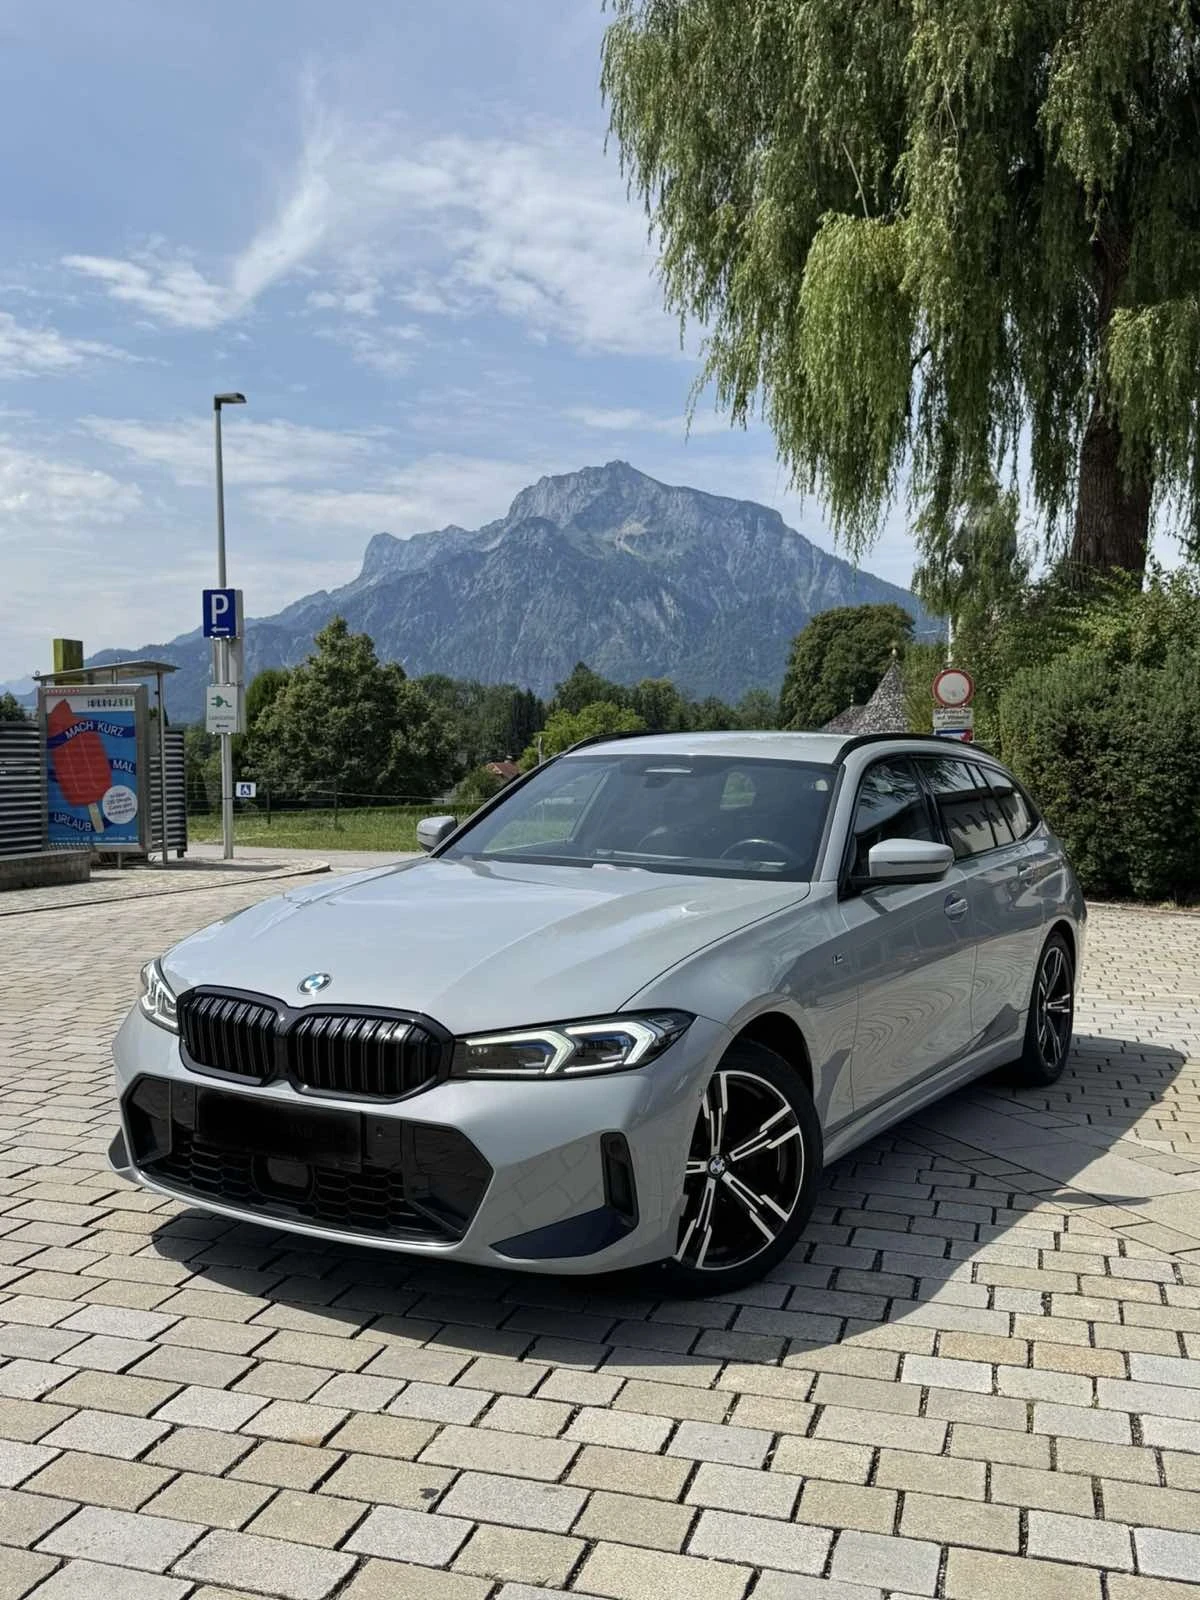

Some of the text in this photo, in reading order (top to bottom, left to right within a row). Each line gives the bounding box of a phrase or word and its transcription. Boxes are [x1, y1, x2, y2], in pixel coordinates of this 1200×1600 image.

[211, 594, 229, 625] P
[65, 721, 124, 739] MACH KURZ
[112, 759, 134, 773] MAL
[54, 813, 92, 832] URLAUB
